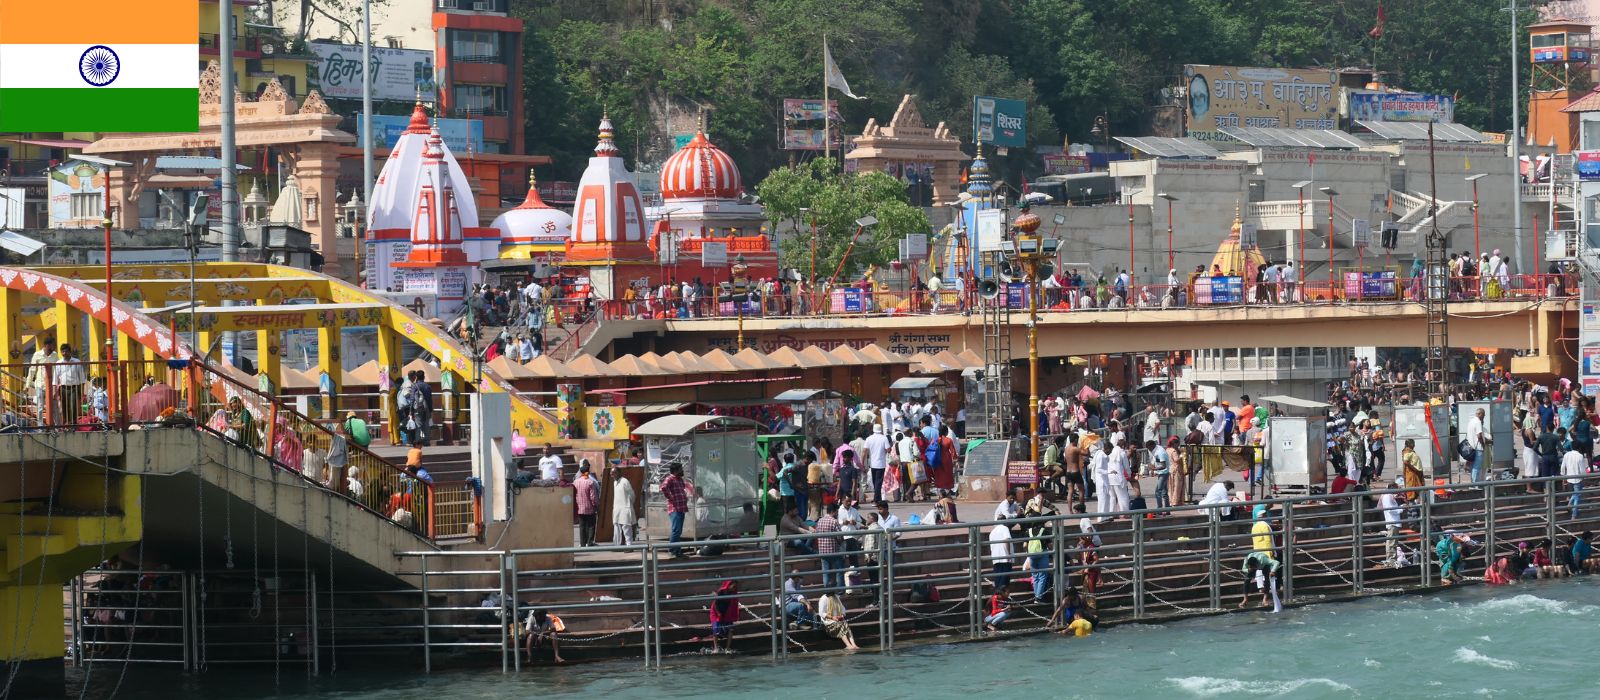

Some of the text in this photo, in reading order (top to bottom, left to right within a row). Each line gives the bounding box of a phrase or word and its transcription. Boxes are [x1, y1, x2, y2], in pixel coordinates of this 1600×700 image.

[1272, 76, 1332, 112] वाहिगुरु
[997, 112, 1022, 130] शिखर
[1214, 111, 1240, 128] ऋषि
[232, 311, 307, 329] स्वागतम्
[888, 332, 951, 344] श्री गंगा सभा
